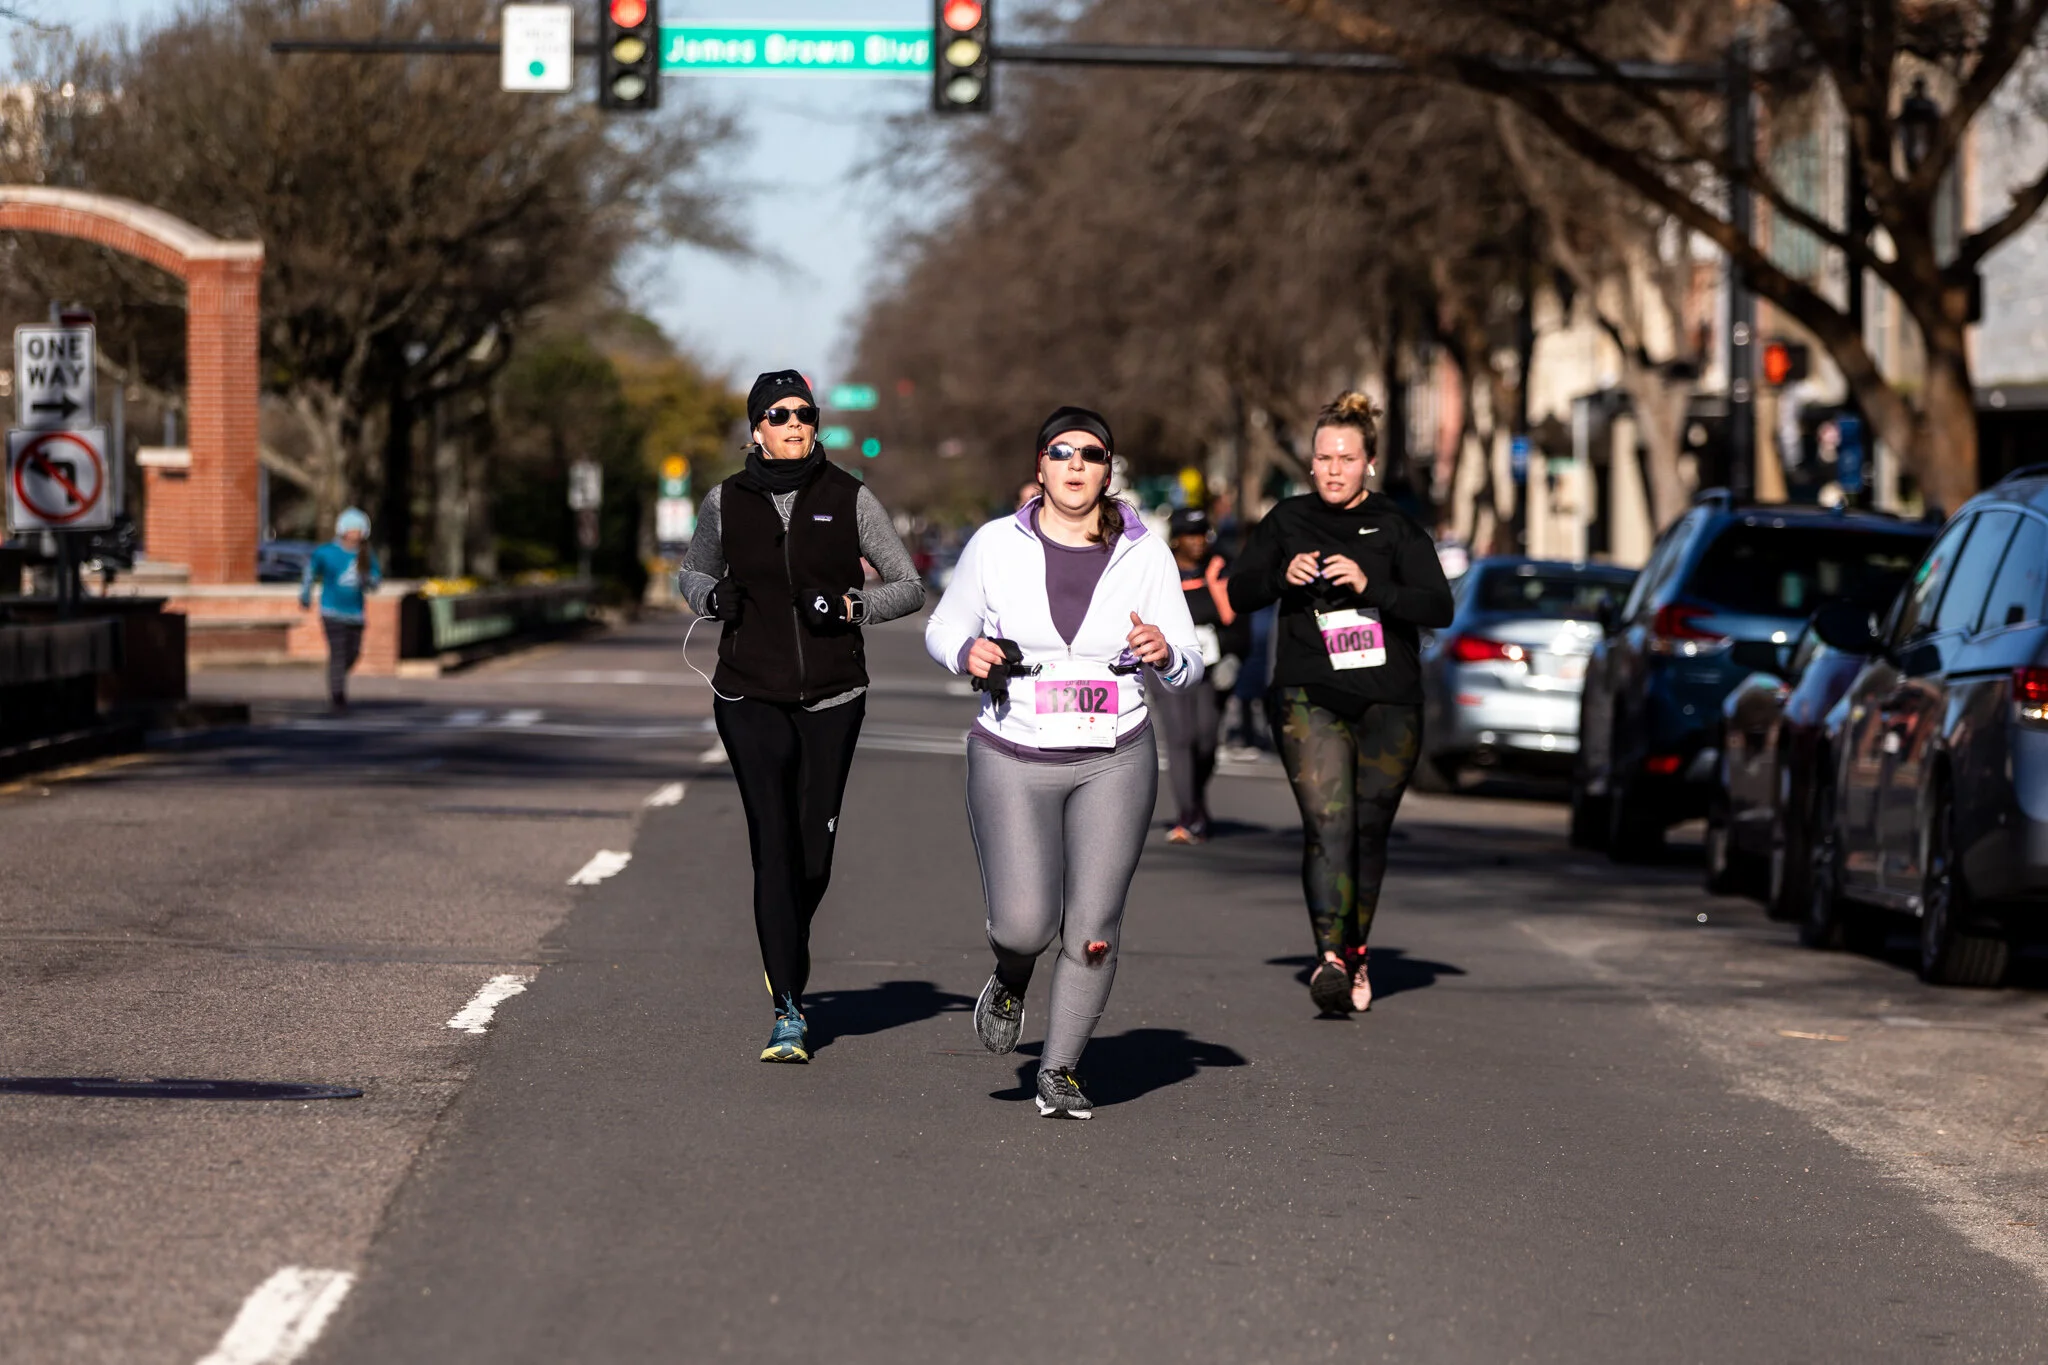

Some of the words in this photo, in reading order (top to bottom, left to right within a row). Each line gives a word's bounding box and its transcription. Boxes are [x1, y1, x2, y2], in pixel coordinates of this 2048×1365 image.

[666, 34, 756, 64] James
[765, 33, 855, 65] Brown
[27, 337, 84, 361] ONE
[28, 366, 85, 387] WAY
[1047, 686, 1109, 713] 1202
